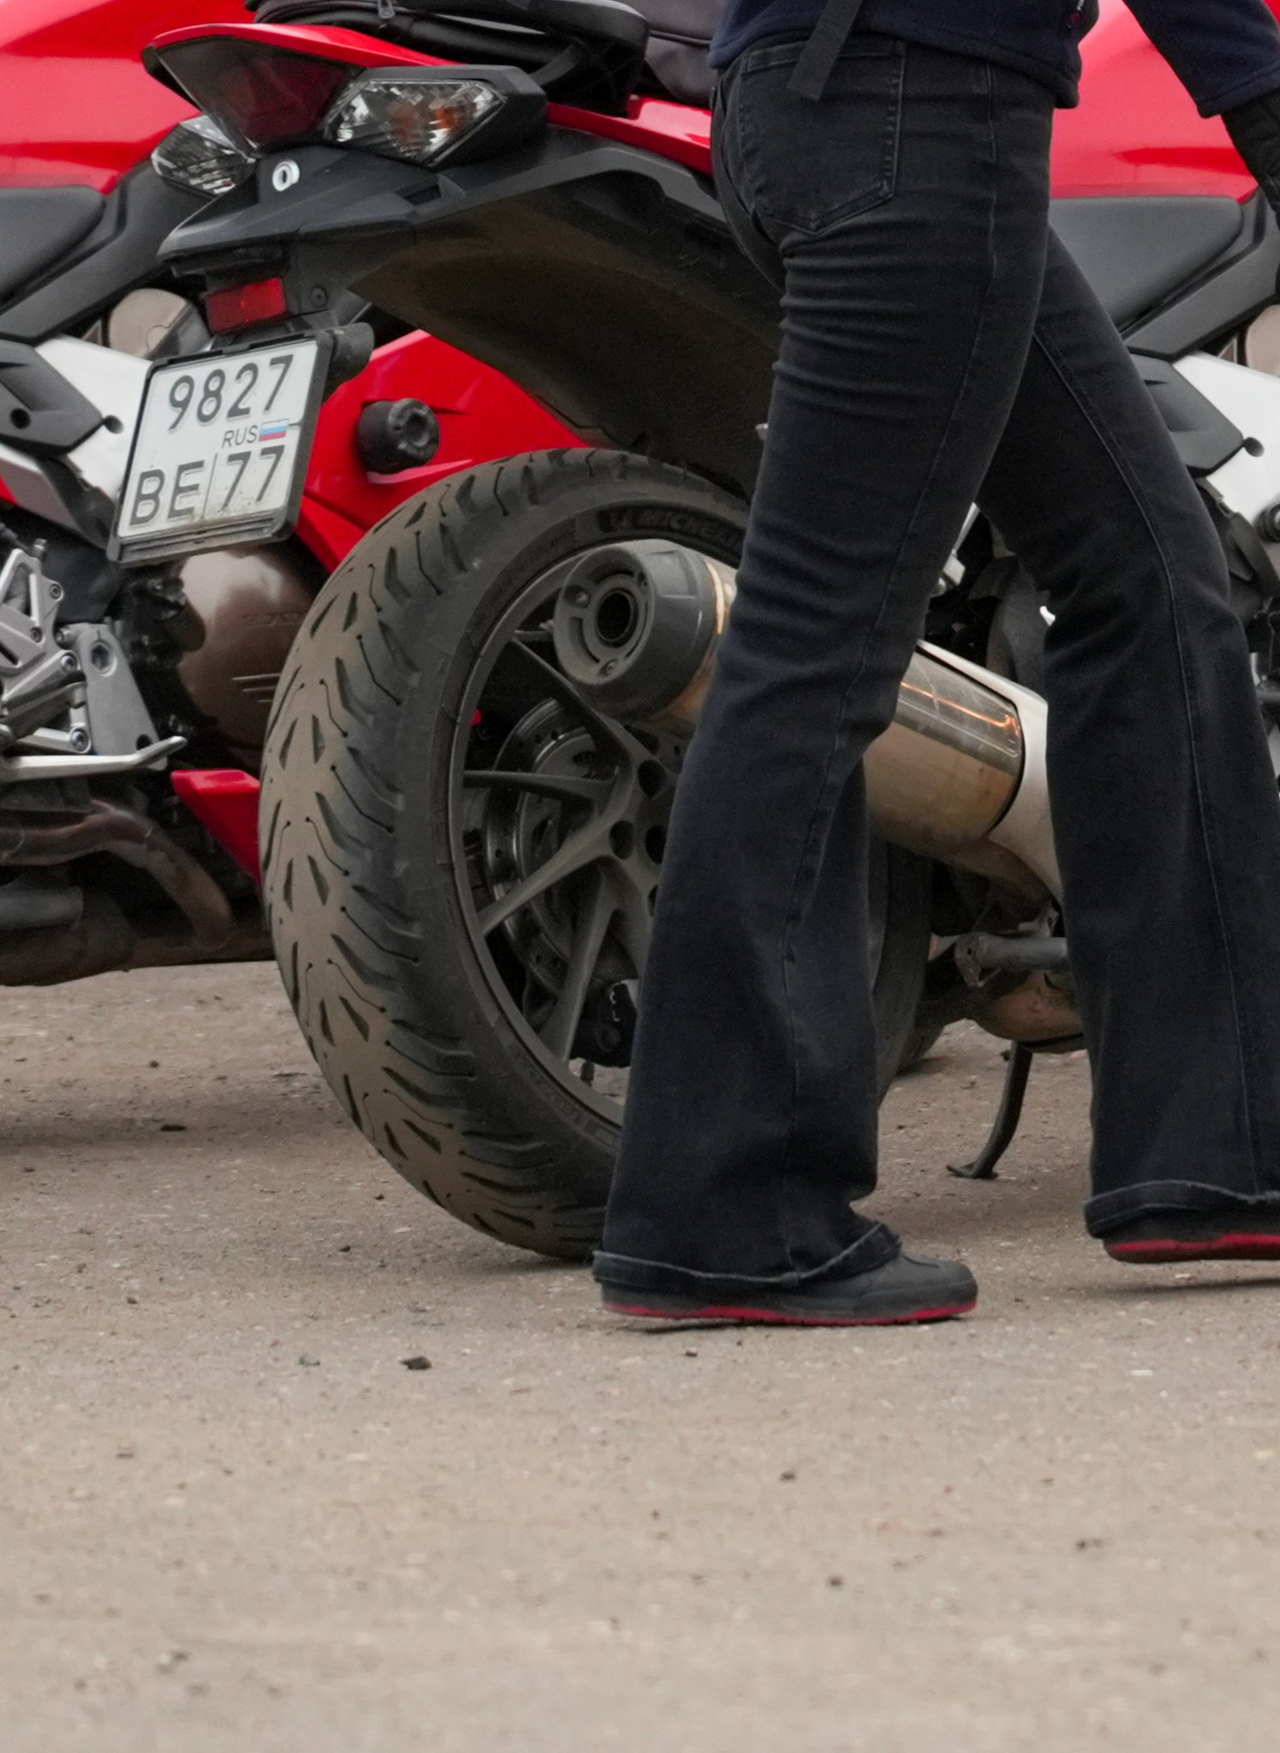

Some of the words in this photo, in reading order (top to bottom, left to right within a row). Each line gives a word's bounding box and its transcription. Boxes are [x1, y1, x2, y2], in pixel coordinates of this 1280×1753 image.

[168, 353, 294, 431] 9827
[222, 425, 259, 448] RUS
[218, 444, 285, 510] 77
